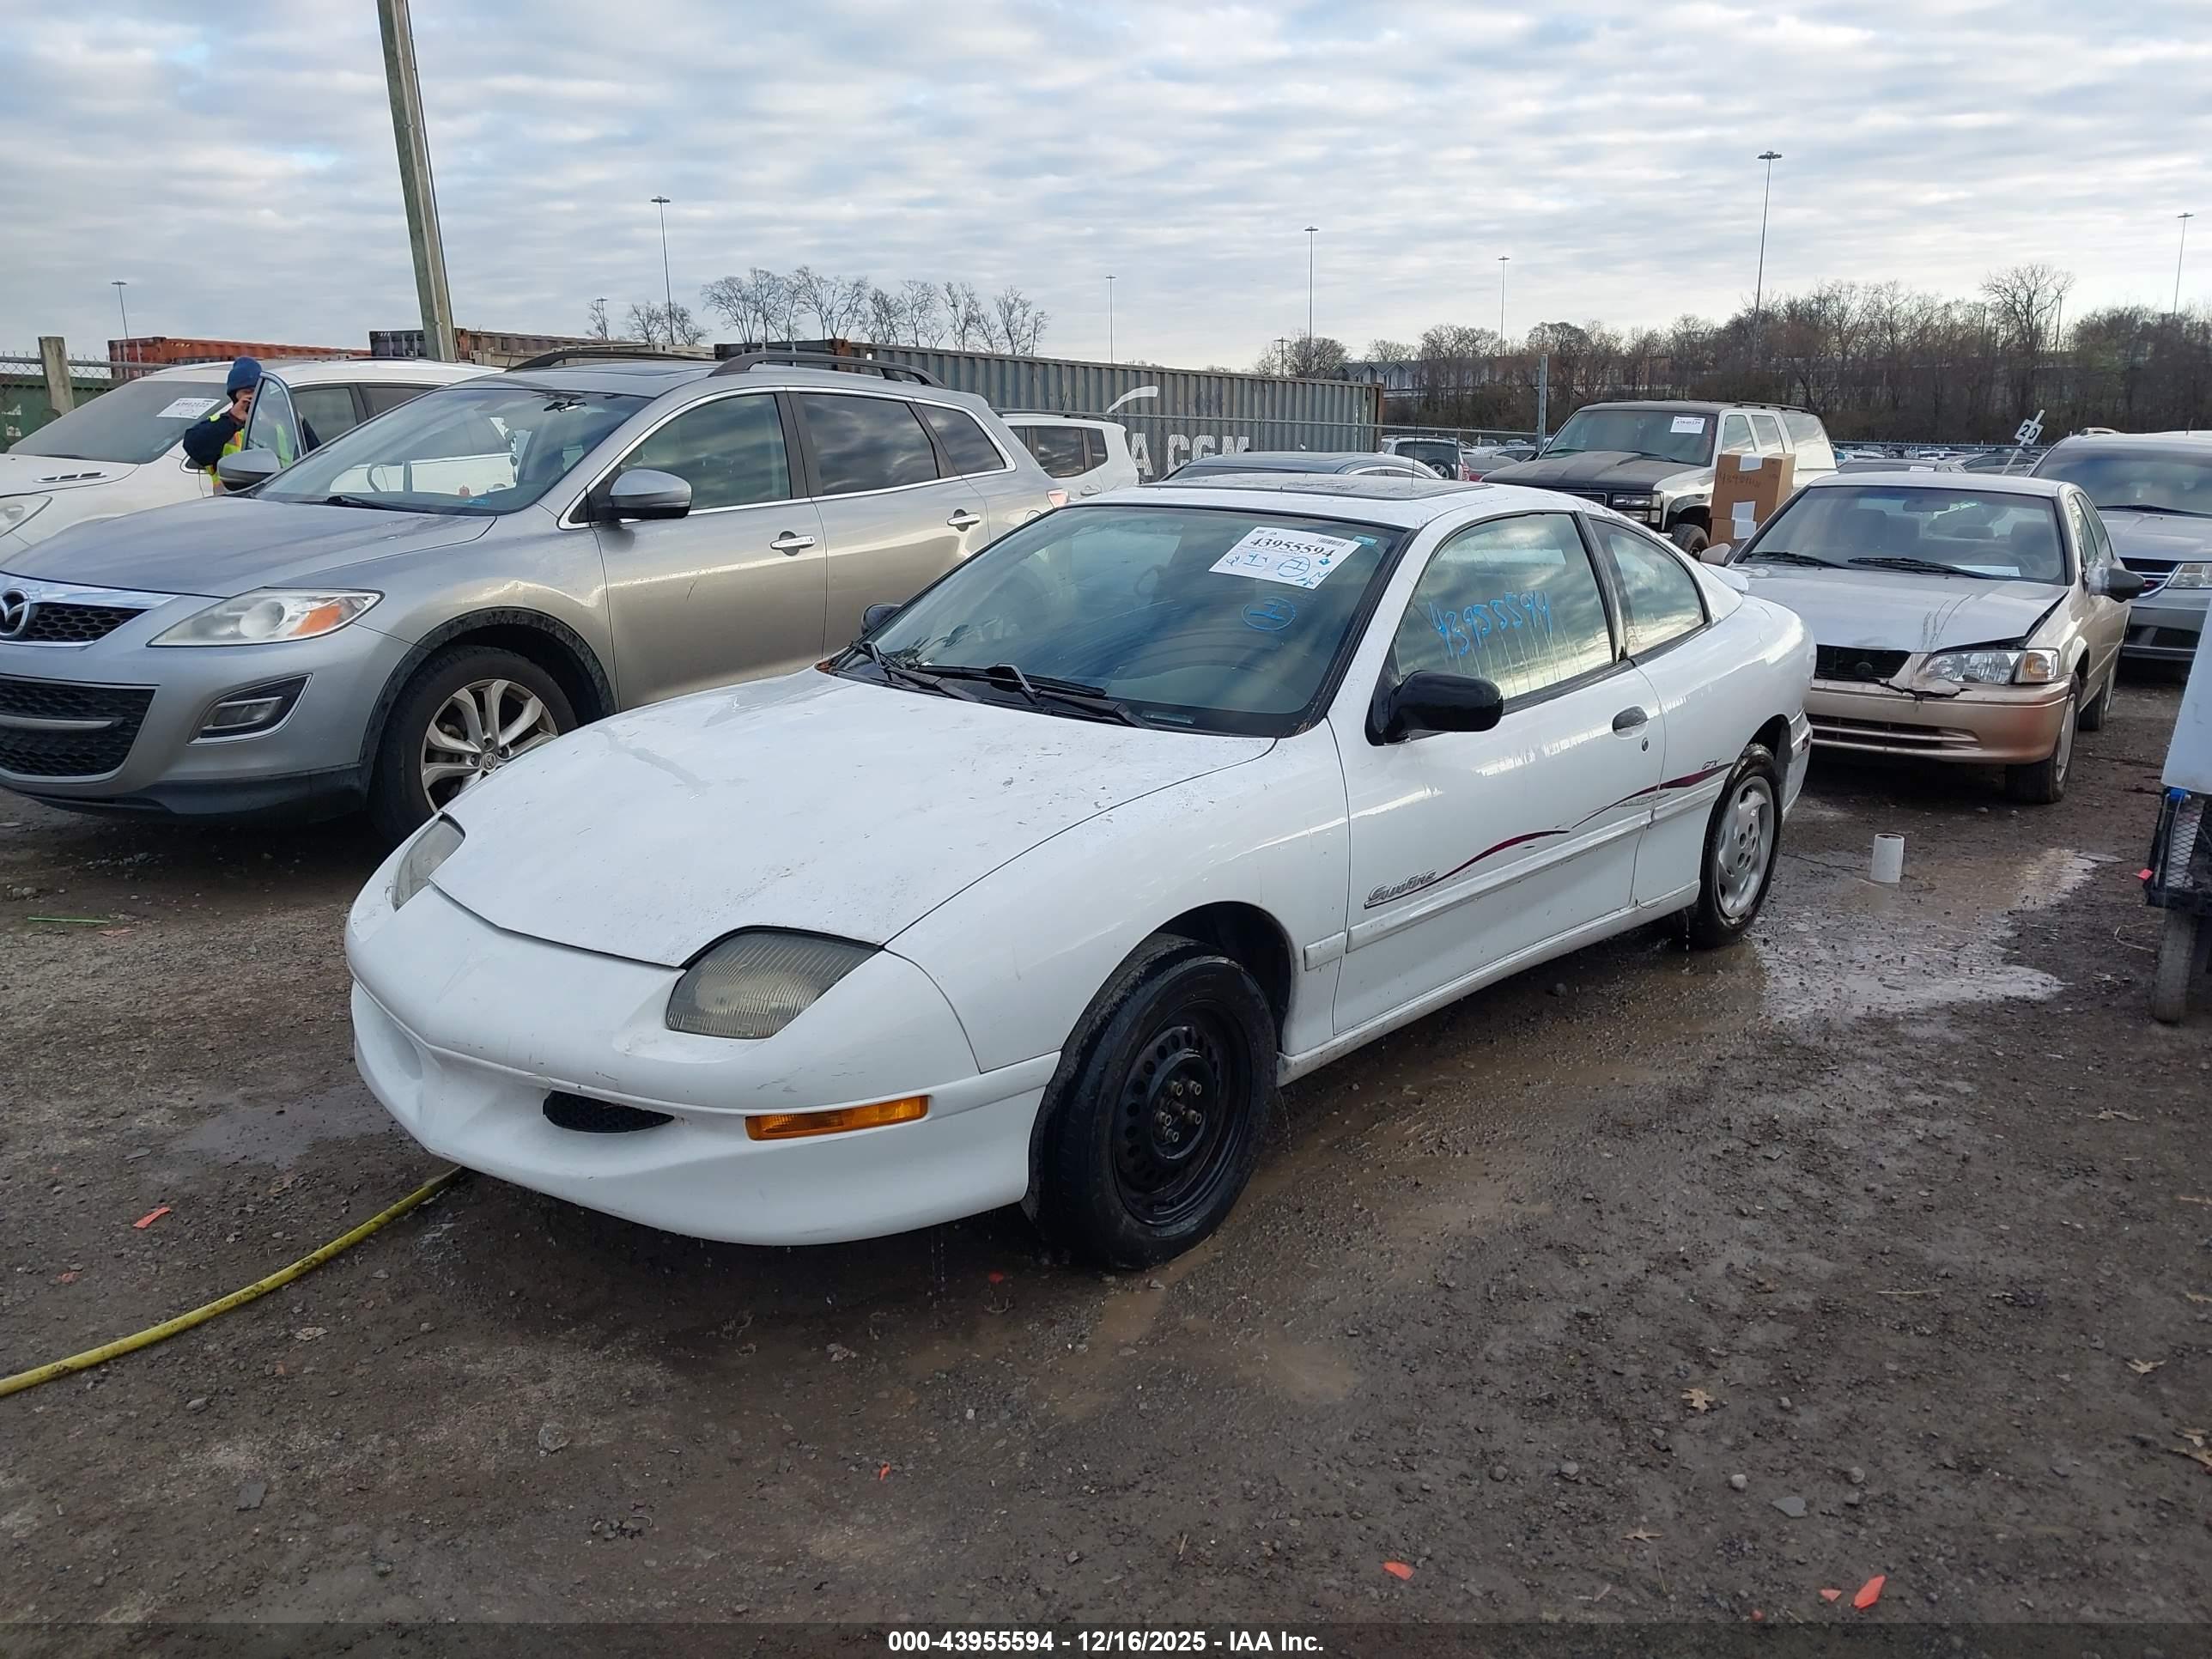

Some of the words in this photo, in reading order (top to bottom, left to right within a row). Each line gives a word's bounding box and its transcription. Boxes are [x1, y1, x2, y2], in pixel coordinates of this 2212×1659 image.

[2020, 424, 2038, 440] 20
[1249, 537, 1336, 557] 43955594
[1429, 590, 1554, 658] 43955594
